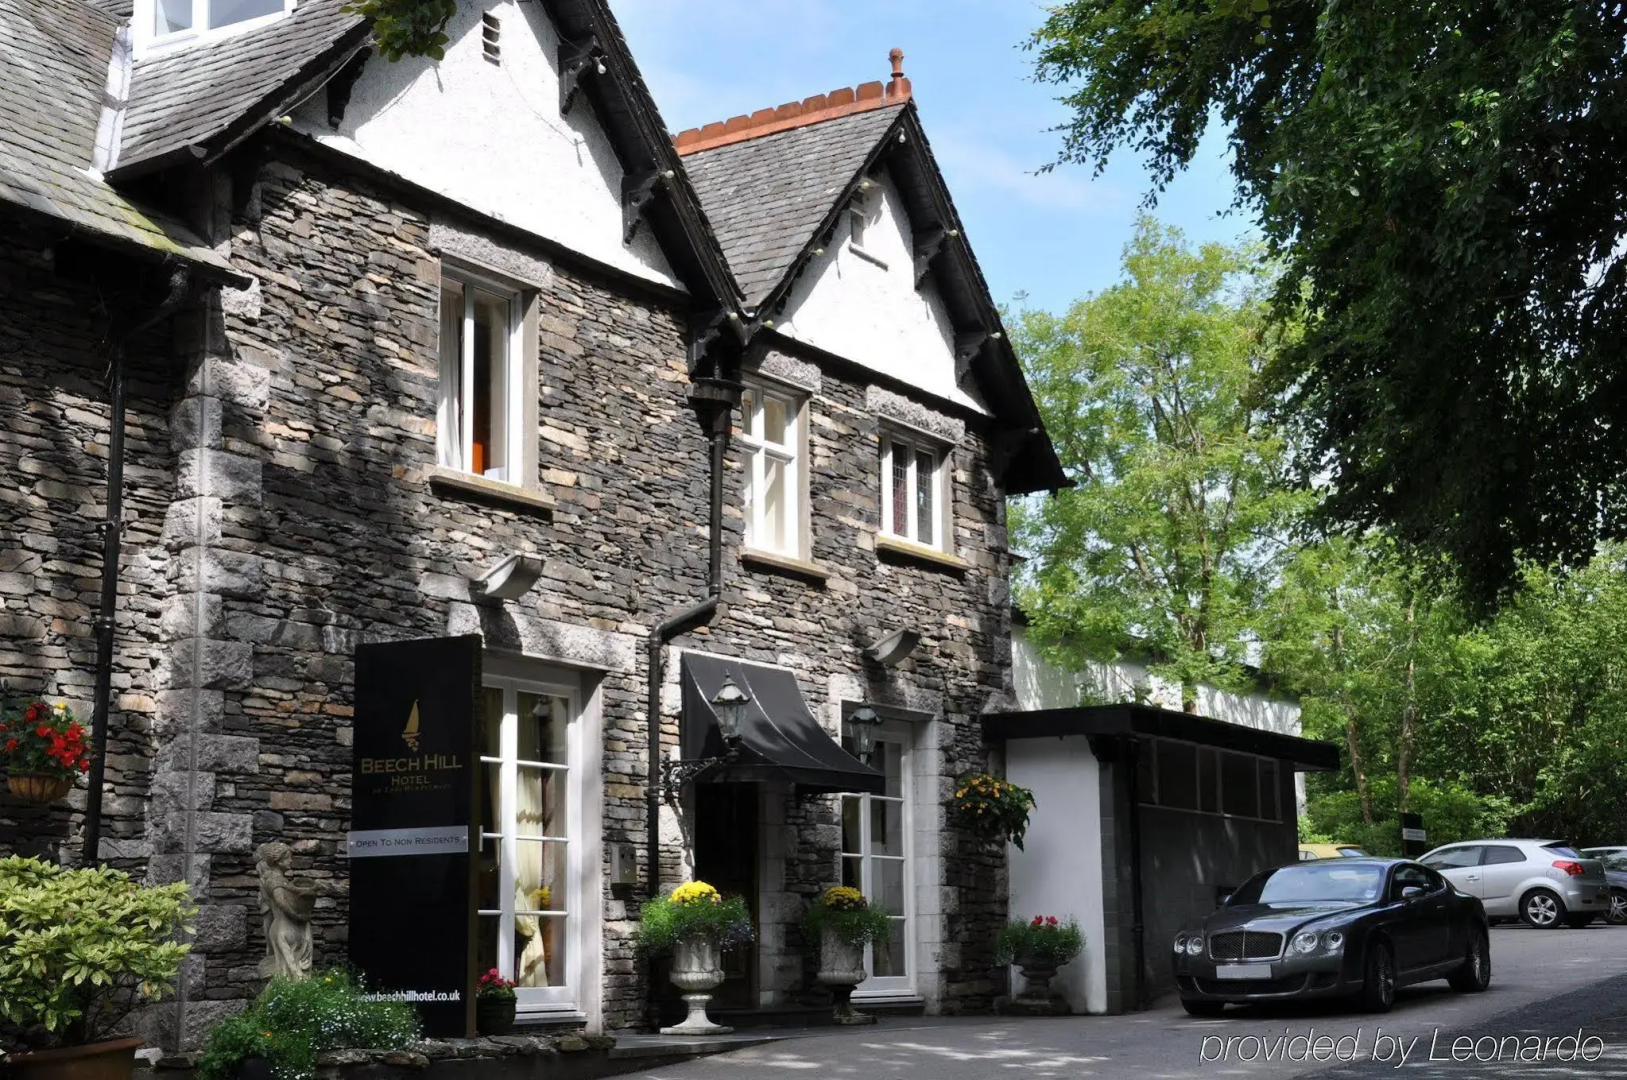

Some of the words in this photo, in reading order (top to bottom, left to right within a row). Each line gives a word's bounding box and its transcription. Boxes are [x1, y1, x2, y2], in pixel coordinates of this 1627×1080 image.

[361, 758, 420, 774] BEECH
[424, 754, 463, 770] HILL
[391, 775, 430, 786] HOTEL
[356, 840, 378, 848] OPEN
[394, 838, 413, 846] NON
[415, 836, 460, 845] RESIDENTS
